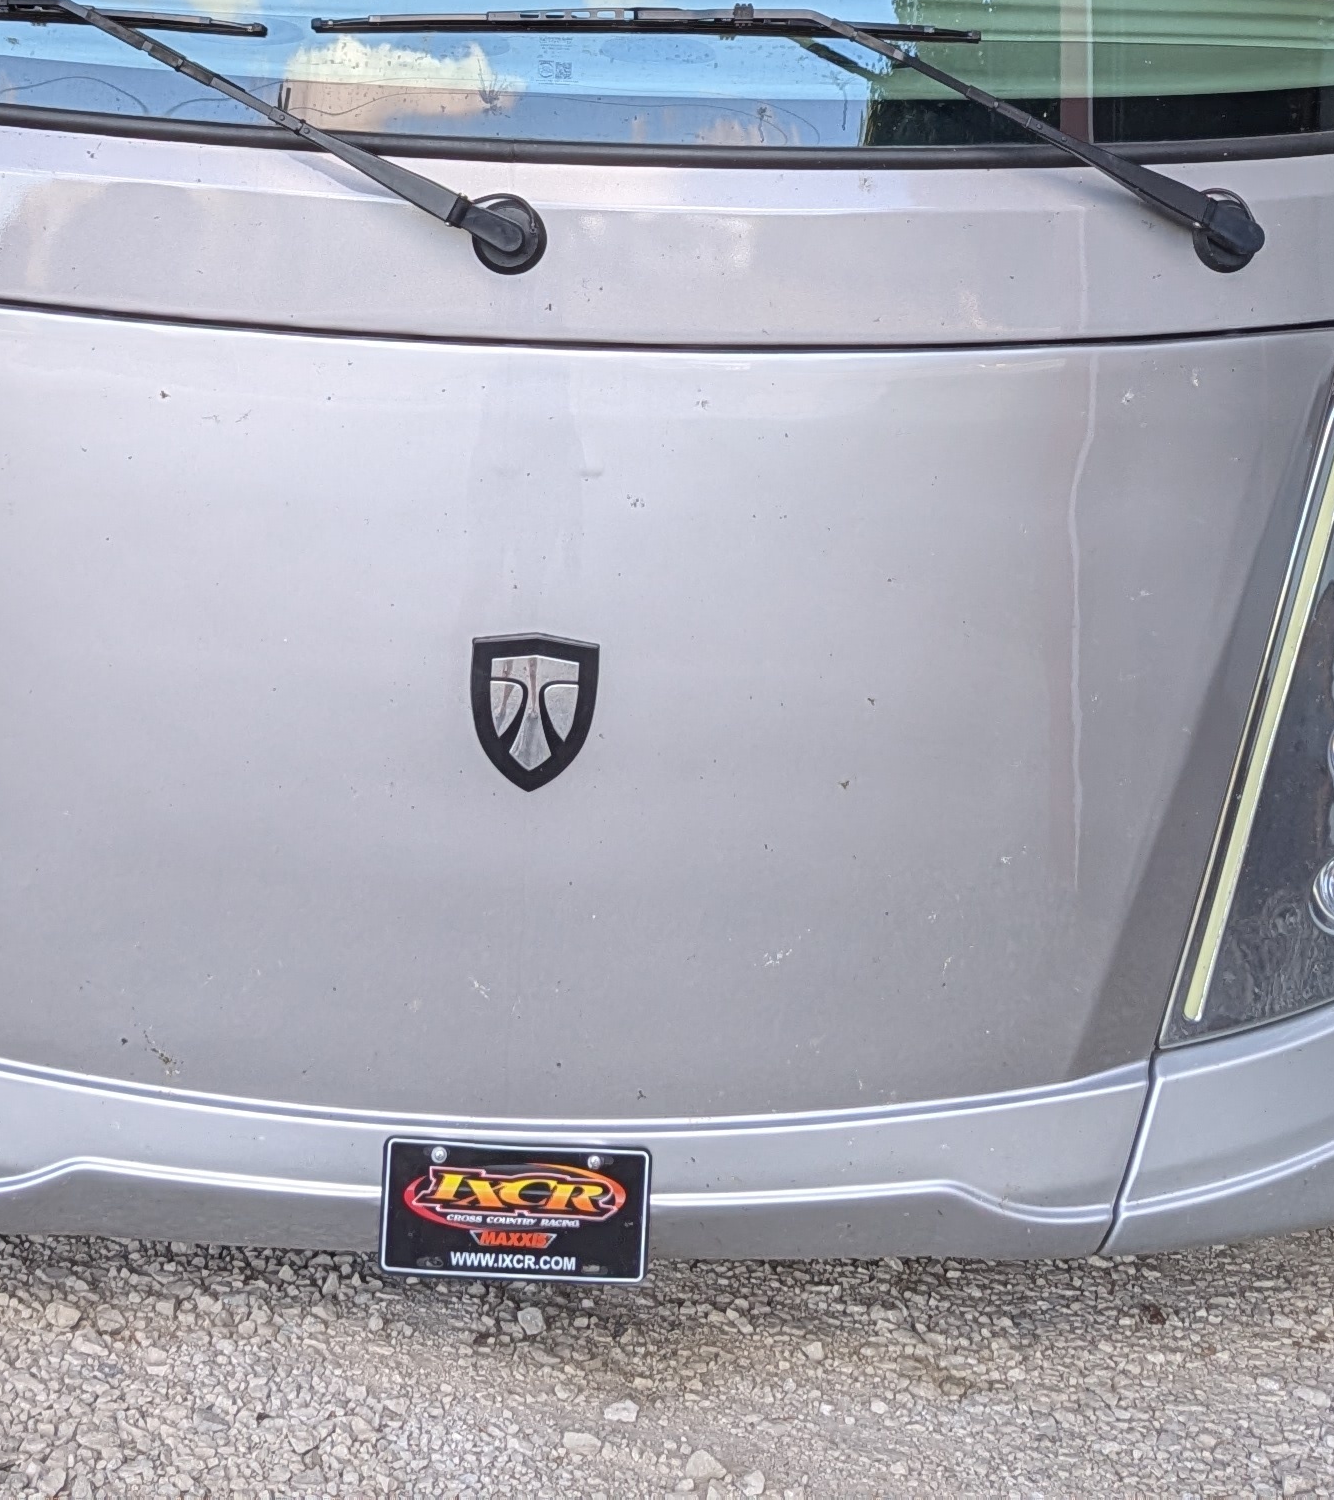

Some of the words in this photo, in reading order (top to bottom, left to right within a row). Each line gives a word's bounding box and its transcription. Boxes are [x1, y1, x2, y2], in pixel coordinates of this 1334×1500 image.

[429, 1172, 602, 1213] IXCR
[445, 1213, 483, 1224] CROSS
[486, 1216, 538, 1228] COUNTRY
[539, 1218, 581, 1229] RACING
[479, 1231, 550, 1247] MAXXIS
[449, 1250, 577, 1272] WWW.IXCR.COM
